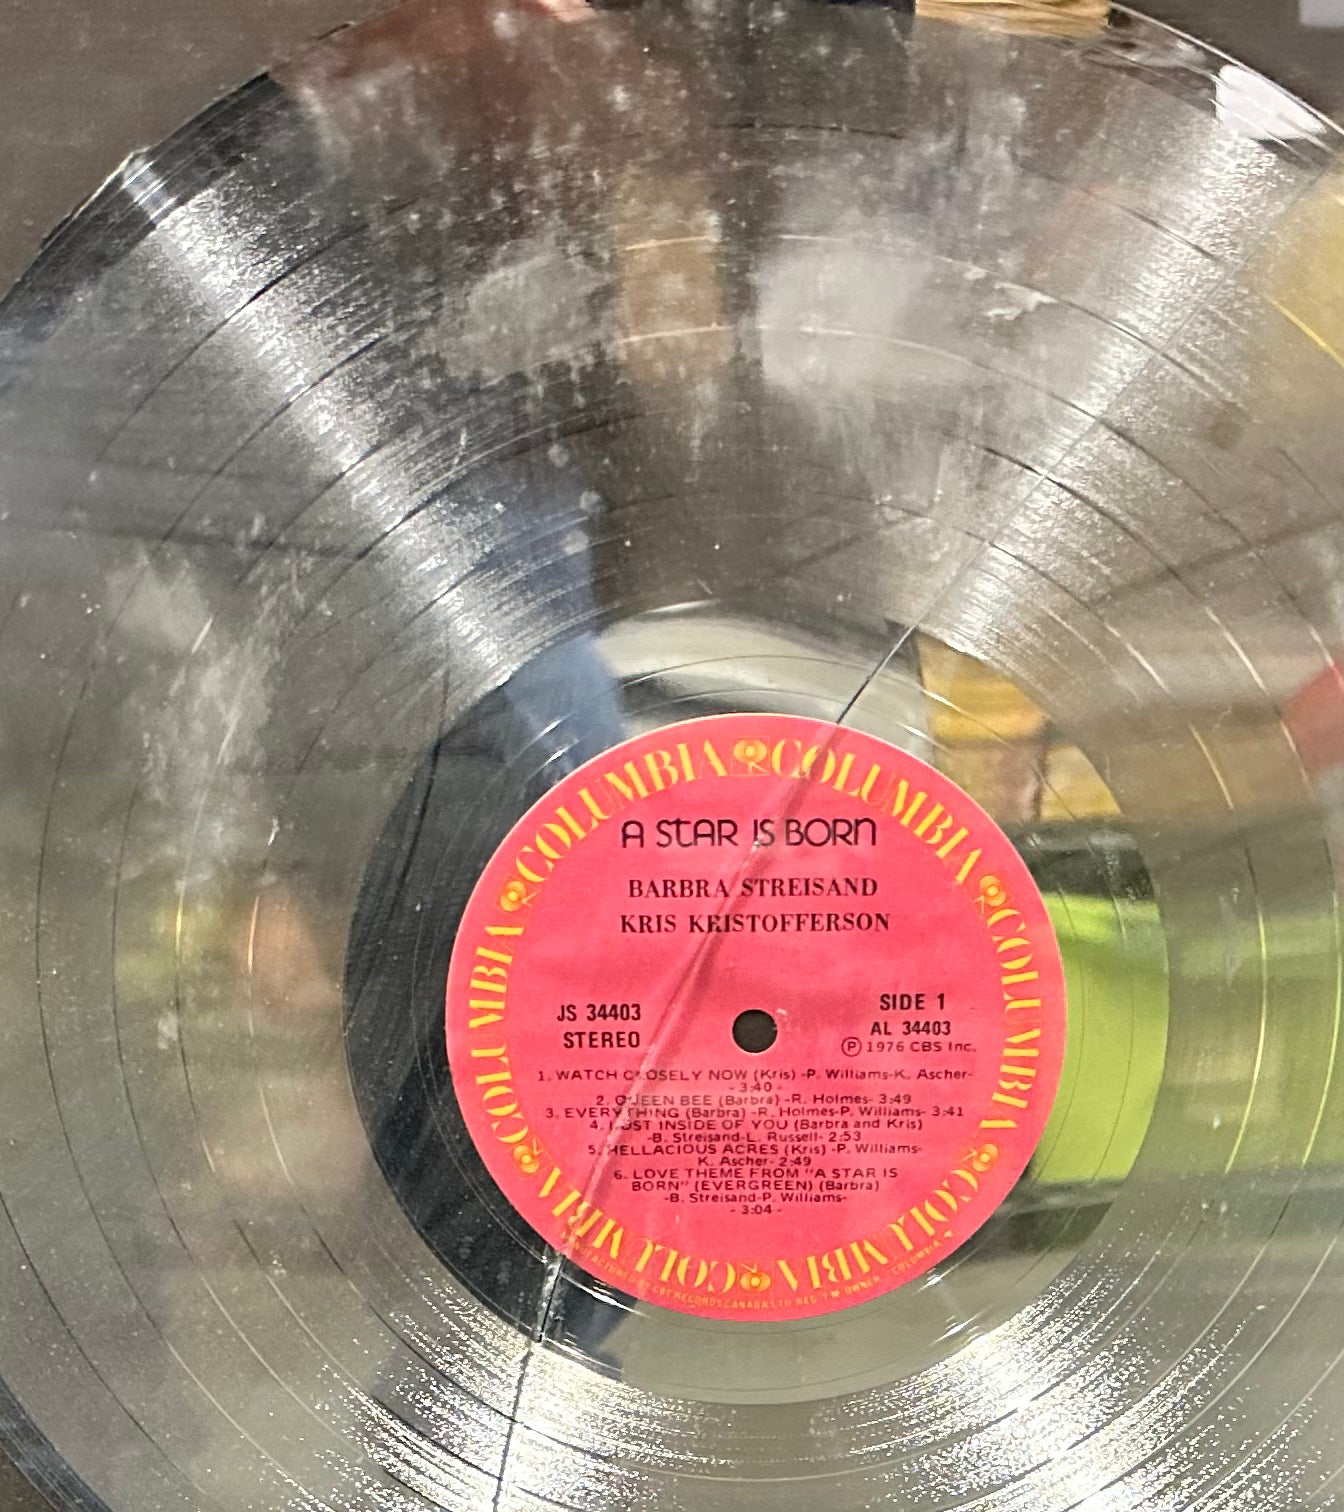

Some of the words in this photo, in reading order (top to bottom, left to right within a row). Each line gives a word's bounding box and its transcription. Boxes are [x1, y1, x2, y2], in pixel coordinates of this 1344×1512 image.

[515, 737, 726, 883] COLUMBIA
[771, 736, 984, 884] COLUMBIA
[621, 820, 644, 848] A
[753, 819, 775, 847] IS
[628, 878, 729, 898] BARBRA
[741, 877, 878, 897] STREISAND
[621, 914, 677, 934] KRIS
[689, 912, 890, 933] KRISTOFFERSON
[879, 993, 925, 1011] SIDE
[937, 993, 945, 1010] 1
[557, 1004, 577, 1022] JS
[586, 1003, 641, 1021] 34403
[980, 907, 1042, 1130] COLUMBIA
[469, 925, 534, 1143] COLUMBIA
[870, 1021, 892, 1036] AL
[902, 1020, 951, 1036] 34403
[563, 1031, 641, 1049] STEREO
[866, 1041, 904, 1053] 1976
[909, 1041, 942, 1053] CBS
[556, 1070, 617, 1081] WATCH
[624, 1069, 702, 1081] COSELY
[708, 1069, 748, 1080] NOW
[754, 1068, 796, 1081] (Kris)
[680, 1095, 712, 1106] BEE
[719, 1094, 779, 1107] (Barbra)
[879, 1093, 911, 1104] 3:49
[686, 1107, 746, 1119] (Barbra)
[932, 1106, 963, 1117] 3:41
[659, 1120, 716, 1130] INSIDE
[722, 1120, 744, 1130] OF
[751, 1120, 788, 1130] YOU
[794, 1119, 849, 1130] (Barbra
[855, 1119, 880, 1129] and
[887, 1119, 923, 1130] Kris)
[828, 1131, 861, 1142] 2:53
[723, 1144, 778, 1155] ACRES
[784, 1143, 826, 1156] (Kris)
[779, 1156, 811, 1167] 2:49
[633, 1168, 677, 1179] LOVE
[685, 1168, 743, 1179] THEME
[750, 1168, 798, 1178] FROM
[831, 1167, 876, 1178] STAR
[883, 1168, 898, 1178] IS
[695, 1180, 812, 1192] (EVERGREEN)
[819, 1180, 879, 1192] (Barbra)
[741, 1204, 773, 1215] 3:04
[537, 1167, 735, 1292] COLUMBIA
[778, 1167, 982, 1291] COLUMBIA
